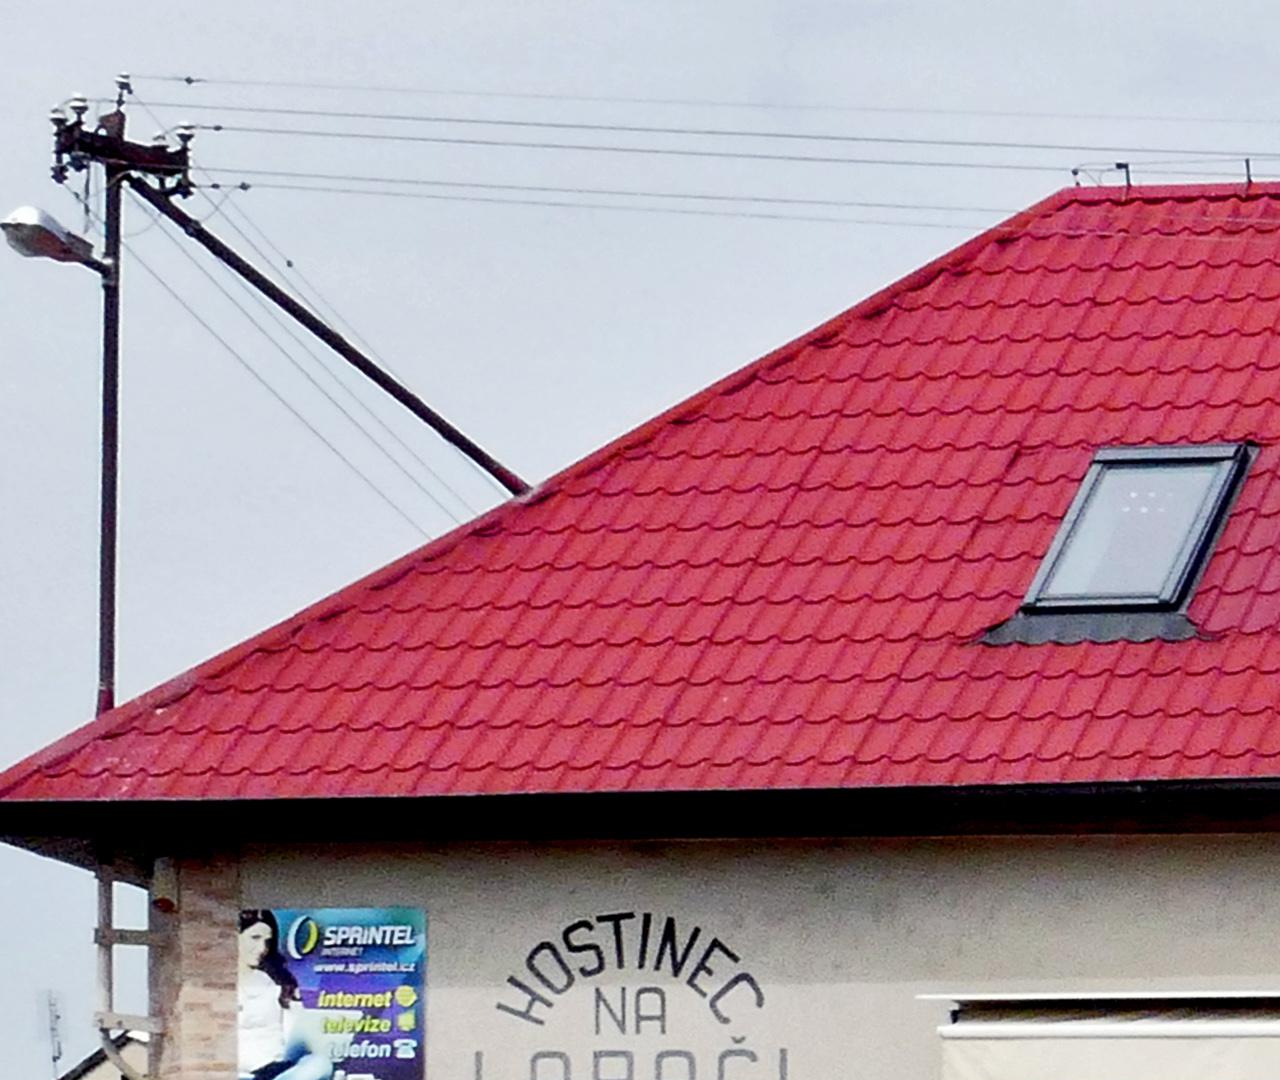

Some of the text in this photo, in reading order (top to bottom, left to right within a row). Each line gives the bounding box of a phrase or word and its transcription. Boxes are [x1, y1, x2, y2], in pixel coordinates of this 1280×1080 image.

[323, 925, 417, 946] SPRINTEL
[496, 912, 765, 1026] HOSTINEC
[595, 986, 667, 1035] NA
